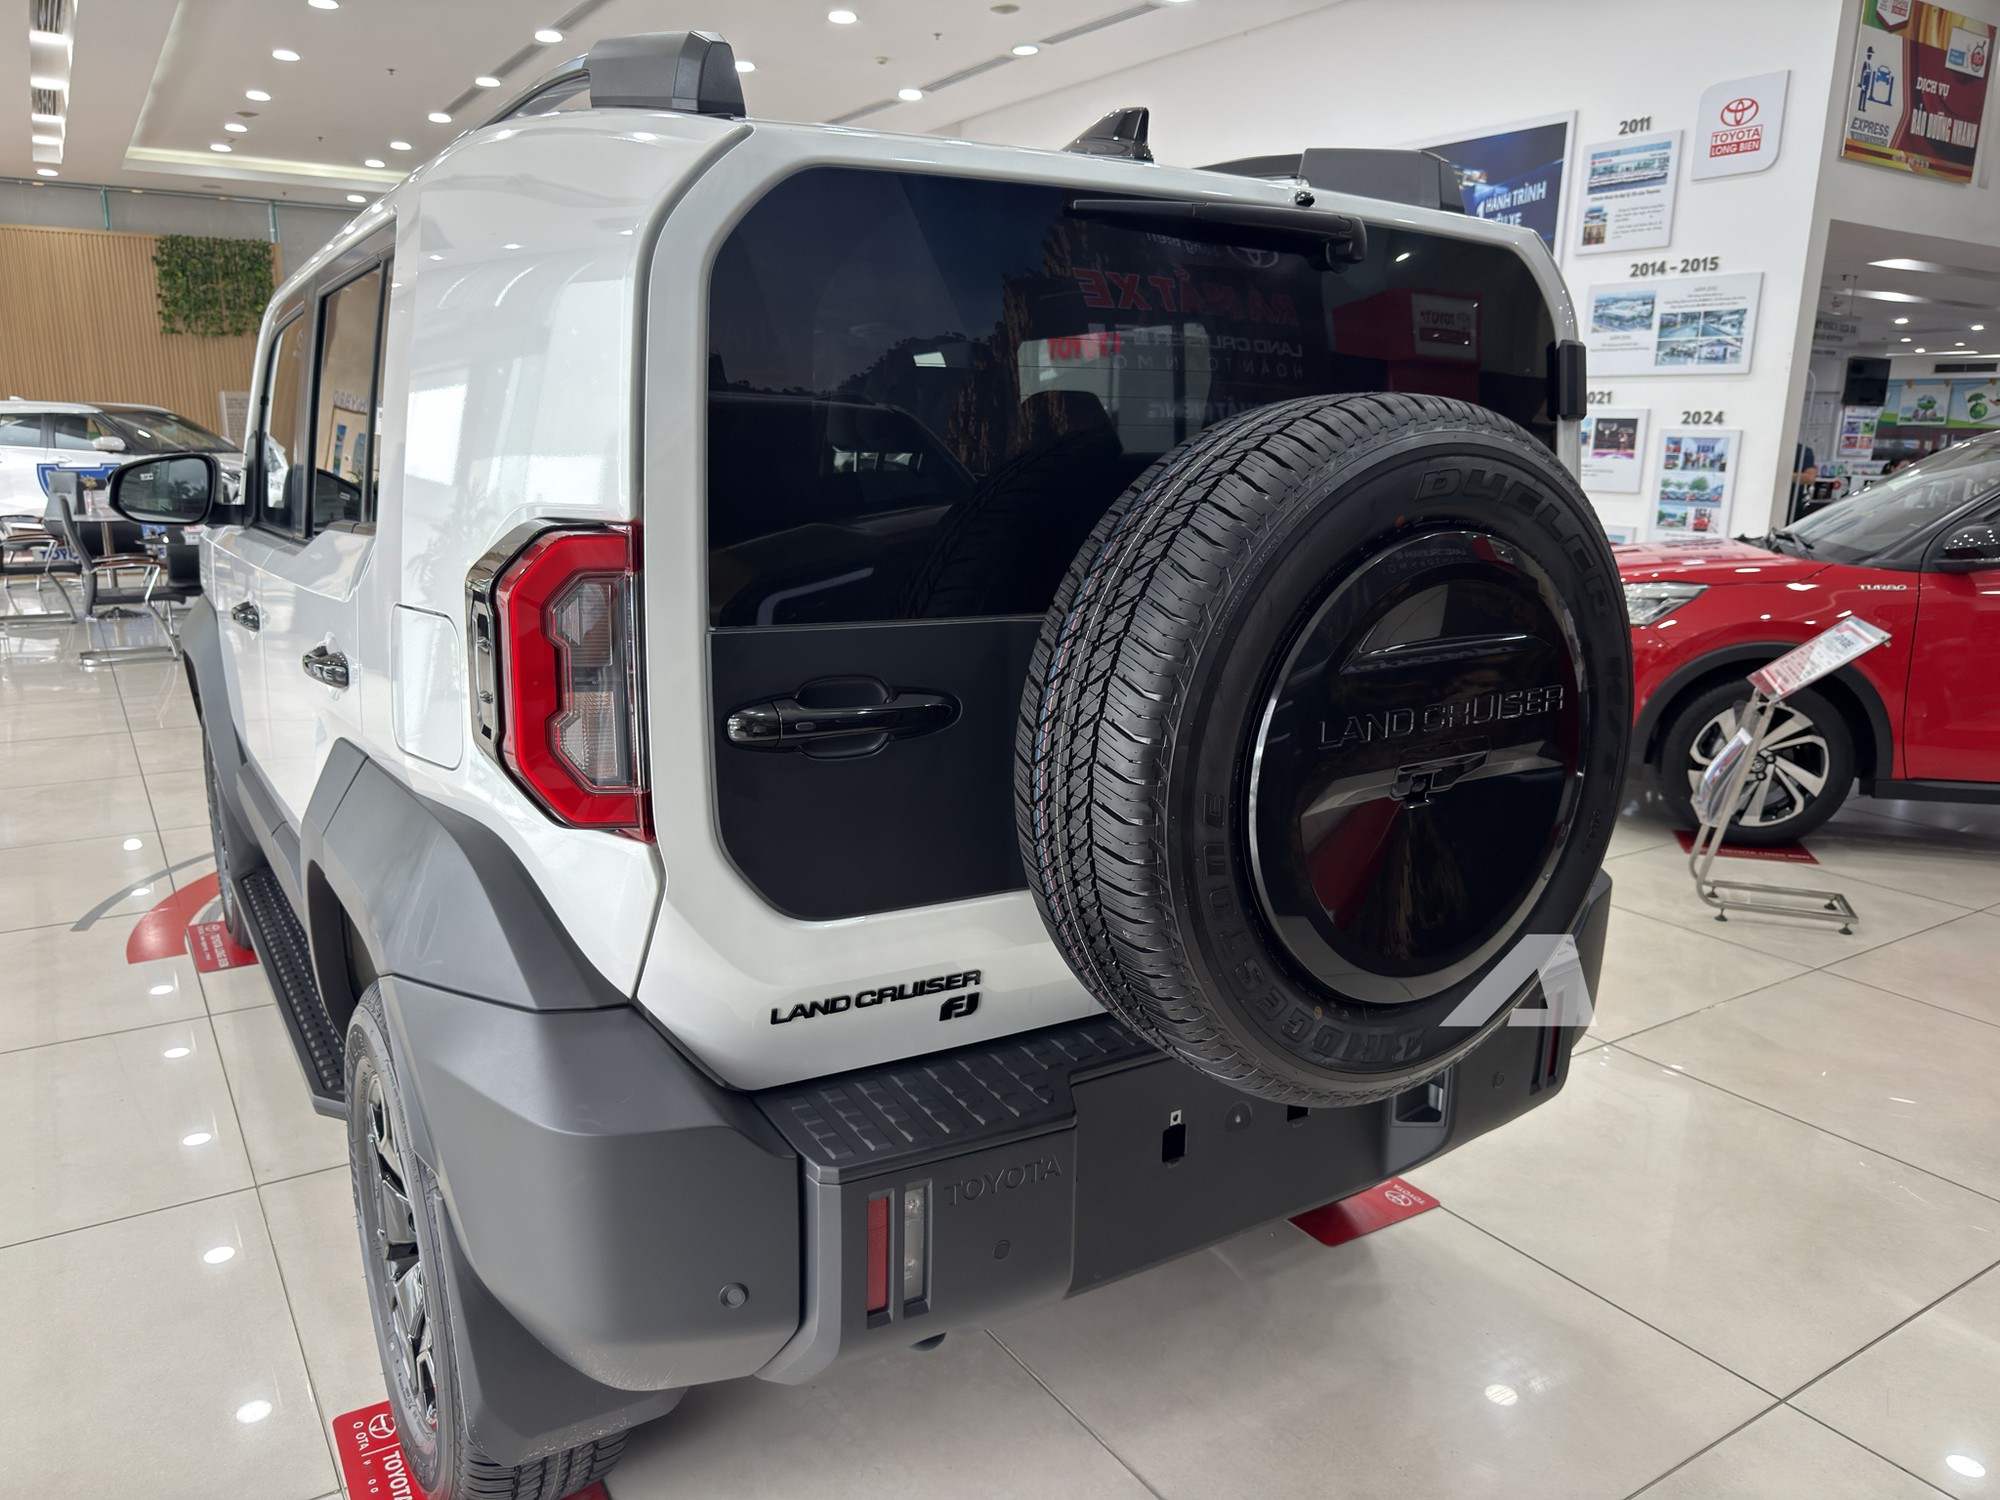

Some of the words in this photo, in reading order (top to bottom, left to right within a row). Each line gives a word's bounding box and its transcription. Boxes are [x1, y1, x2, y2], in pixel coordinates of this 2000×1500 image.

[1916, 77, 1938, 94] DỊCH
[1938, 83, 1950, 100] VỤ
[1618, 116, 1652, 136] 2011
[1712, 128, 1760, 144] TOYOTA
[1850, 117, 1890, 137] EXPRESS
[1951, 119, 1978, 149] NHANH
[1711, 144, 1738, 156] LONG
[1486, 191, 1512, 212] HÀNH
[1512, 180, 1547, 206] TRÌNH
[1630, 260, 1666, 278] 2014
[1679, 256, 1720, 274] 2015
[1588, 392, 1613, 404] 021
[1681, 410, 1724, 425] 2024
[1414, 467, 1612, 618] DUELER
[1317, 707, 1416, 750] LAND
[1422, 683, 1566, 732] CRUISER
[770, 995, 852, 1025] LAND
[855, 969, 982, 1009] CRUISER
[939, 992, 980, 1022] FJ
[944, 1154, 1063, 1206] TOYOTA
[1394, 1184, 1425, 1204] TOYOTA
